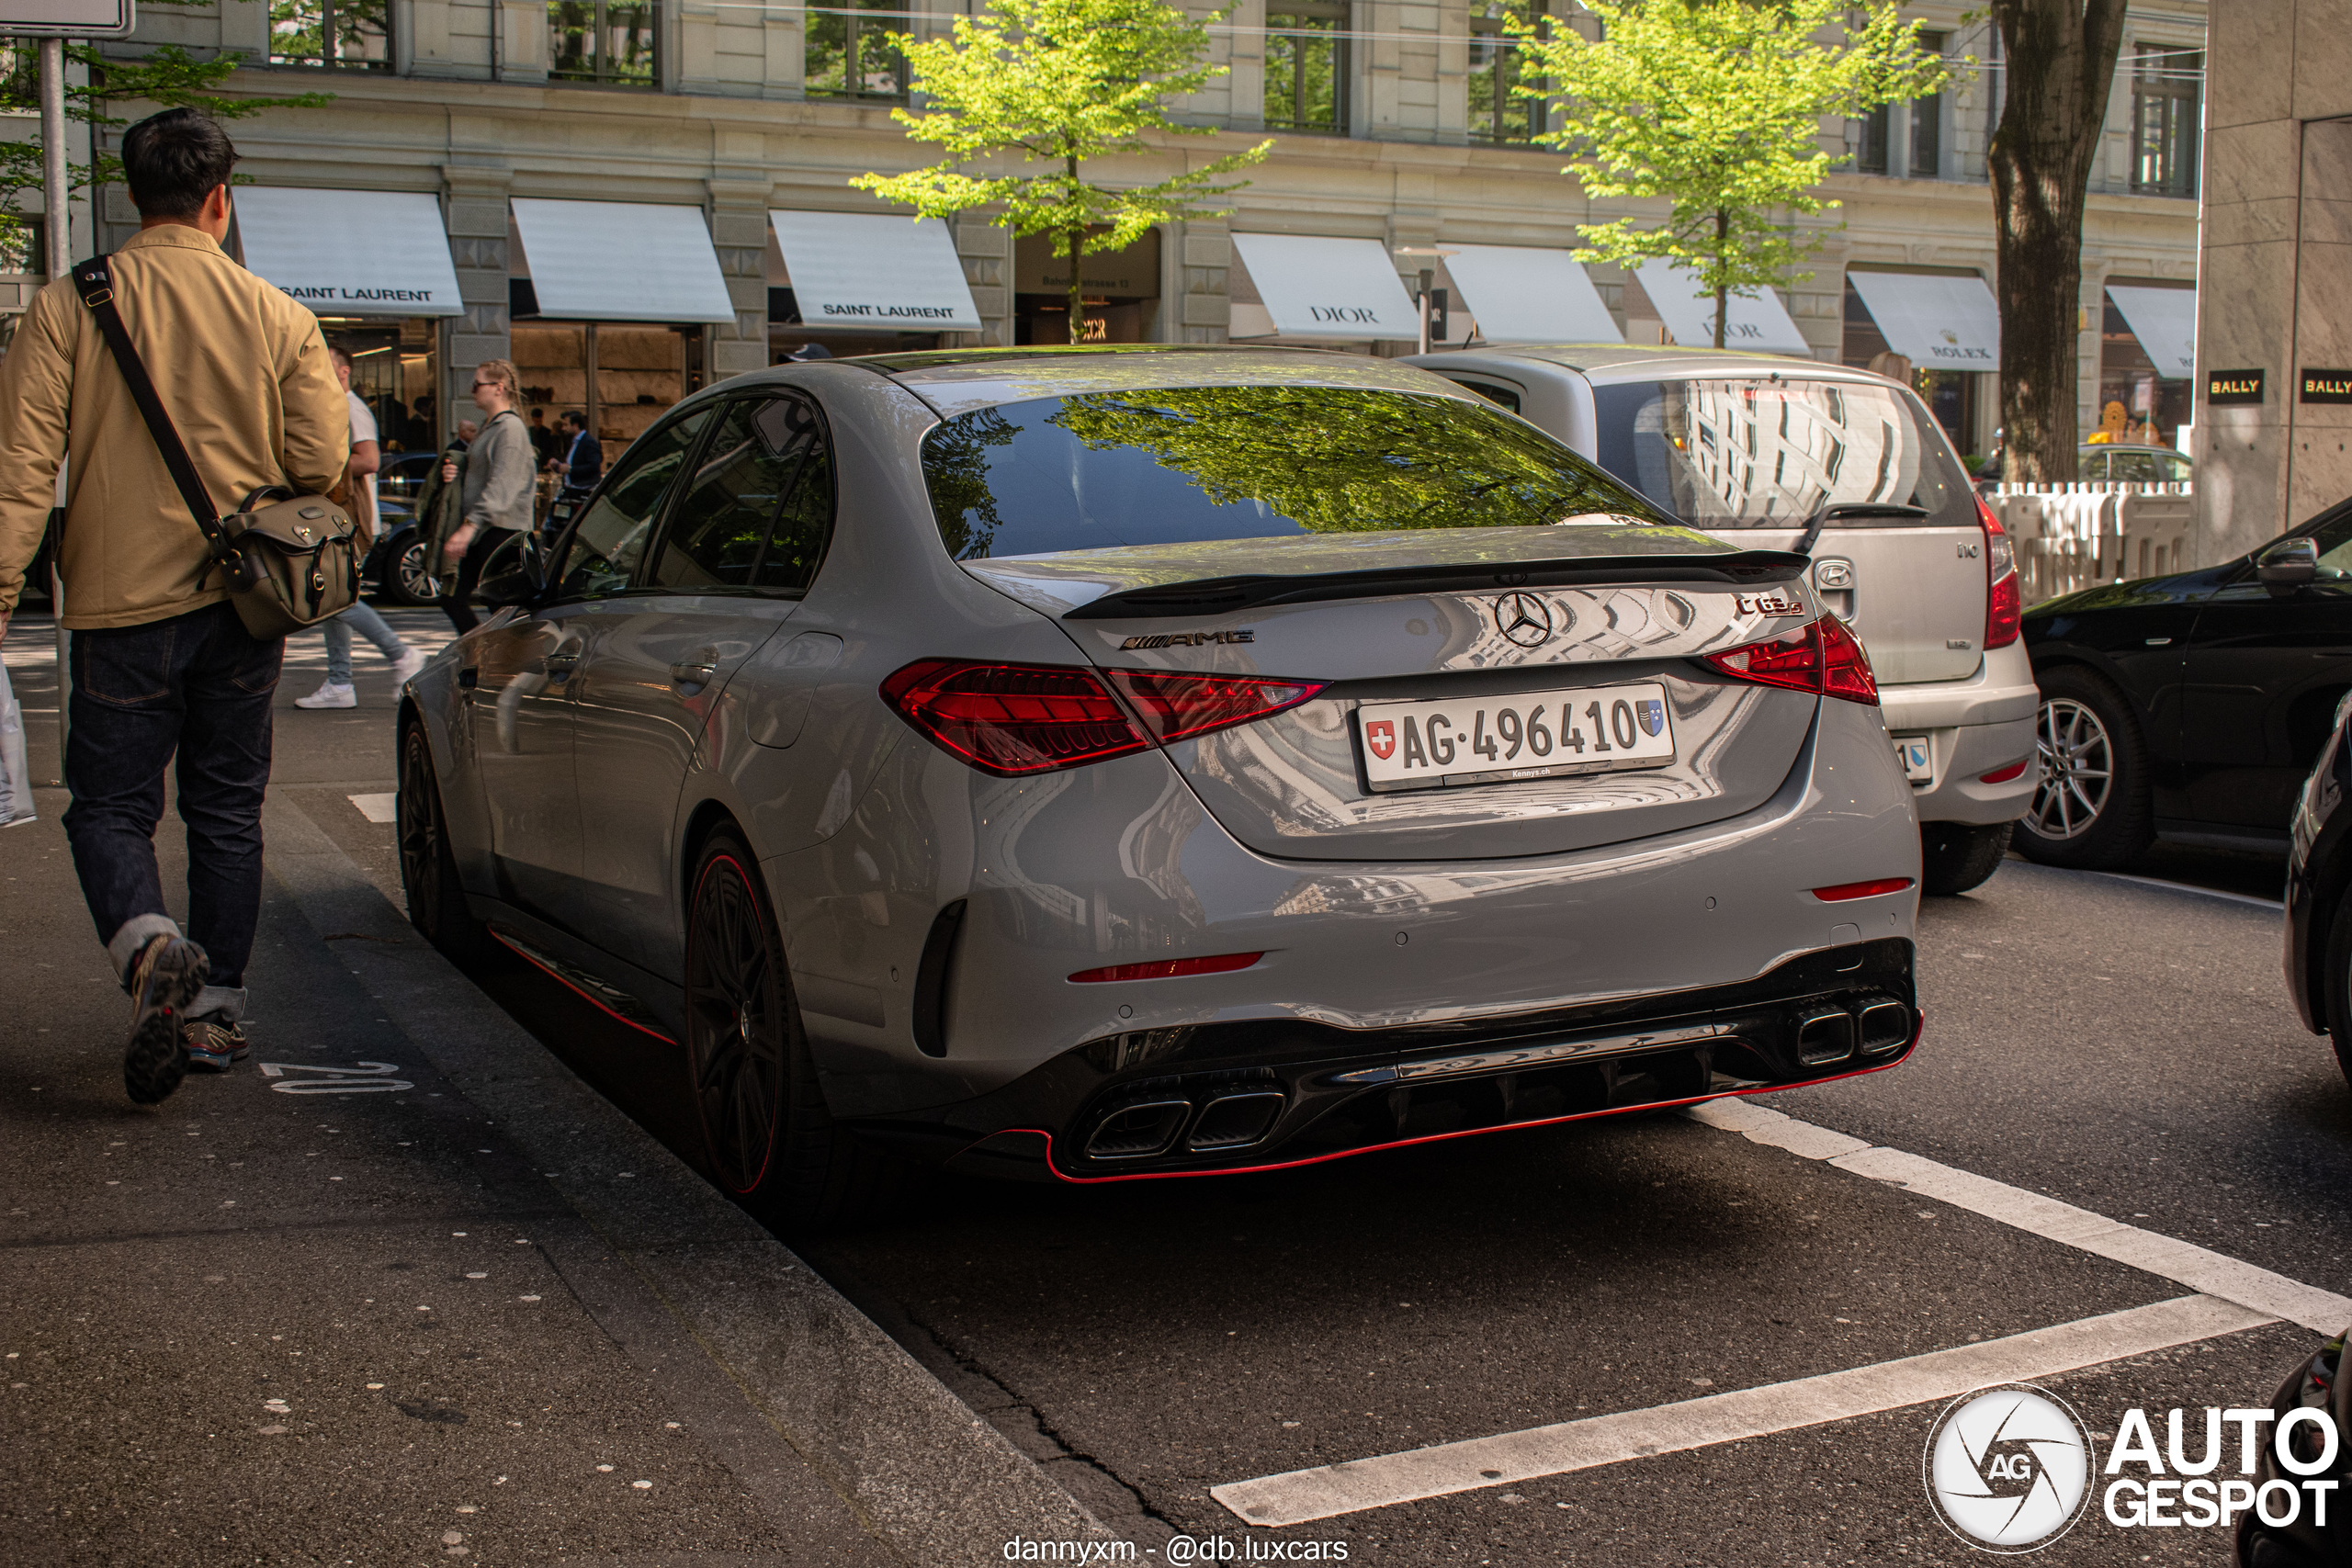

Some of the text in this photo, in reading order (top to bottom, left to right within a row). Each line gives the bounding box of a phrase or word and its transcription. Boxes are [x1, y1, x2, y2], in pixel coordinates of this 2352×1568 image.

[278, 287, 433, 301] SAINT LAURENT
[823, 304, 955, 319] SAINT LAURENT
[1309, 306, 1381, 324] DIOR
[1930, 346, 1992, 359] ROLEX
[2211, 379, 2259, 394] BALLY
[2305, 379, 2352, 394] BALLY
[1162, 629, 1255, 648] AMG
[1512, 768, 1551, 778] Kennys.ch
[258, 1061, 415, 1094] 20
